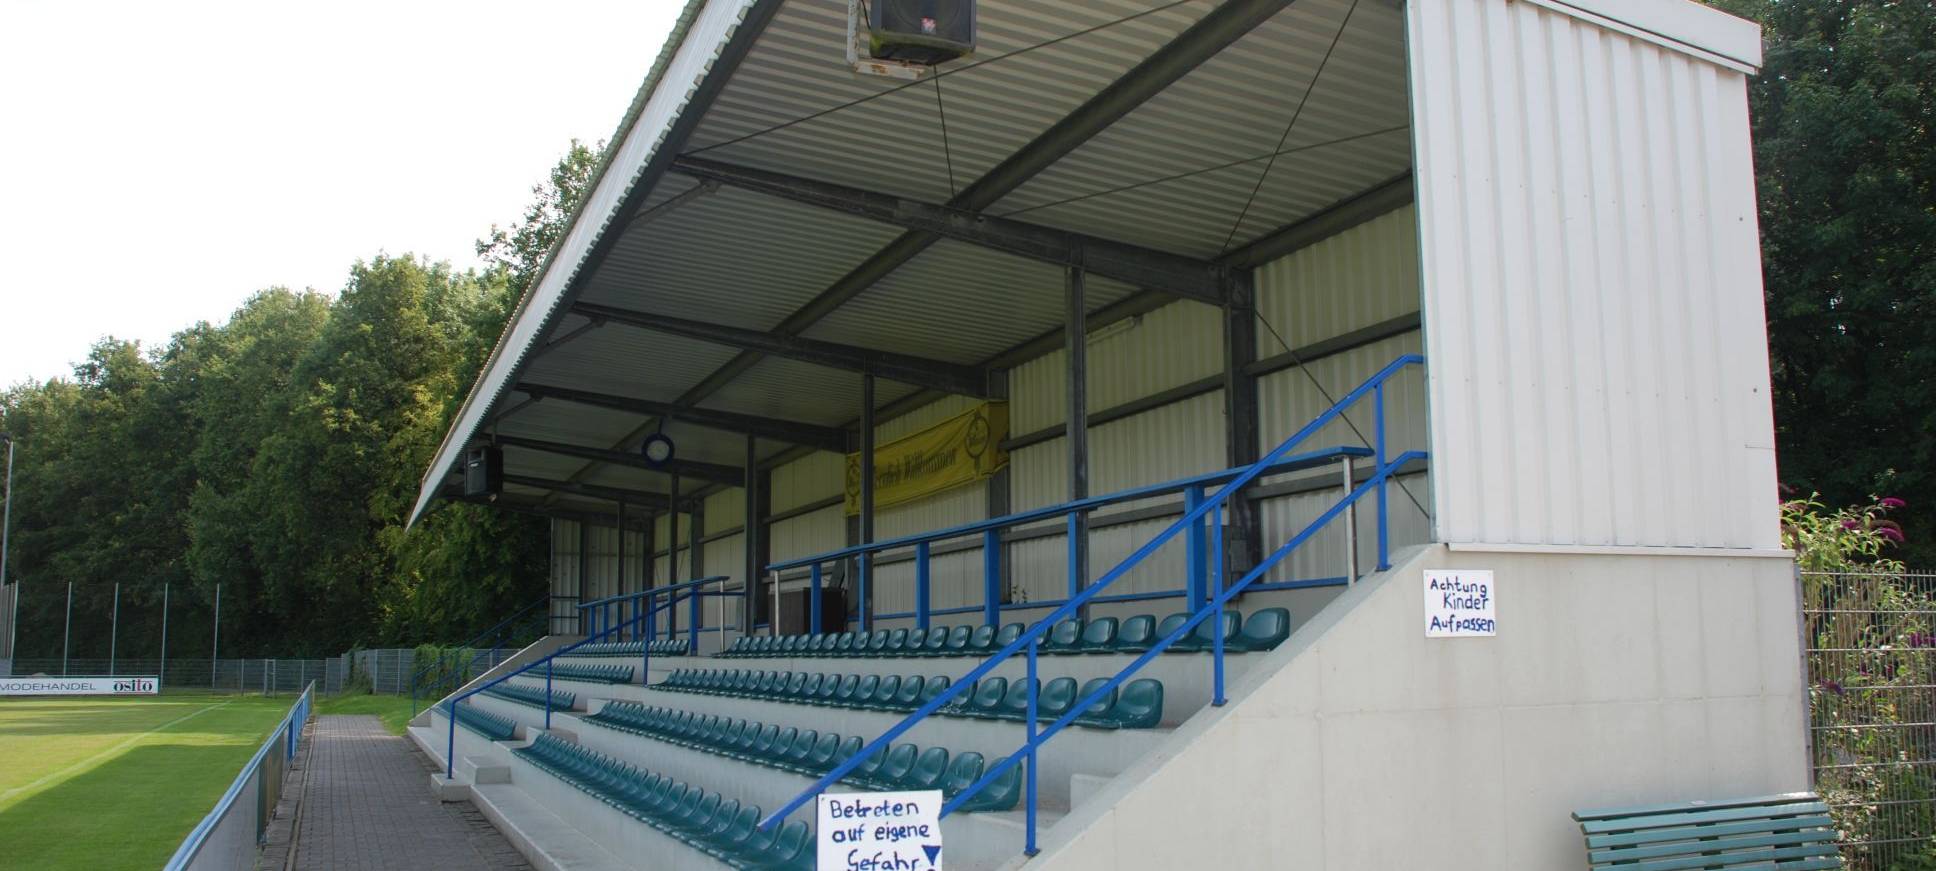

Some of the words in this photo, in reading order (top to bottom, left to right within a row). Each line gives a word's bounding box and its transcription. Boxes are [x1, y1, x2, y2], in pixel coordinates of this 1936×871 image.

[1430, 576, 1487, 598] Achtung
[1443, 592, 1489, 610] Kinder
[1430, 614, 1495, 633] Aufpassen
[0, 682, 97, 691] MODEHANDEL
[830, 799, 919, 818] Betreten
[832, 823, 865, 843] auf
[874, 822, 930, 842] eigene
